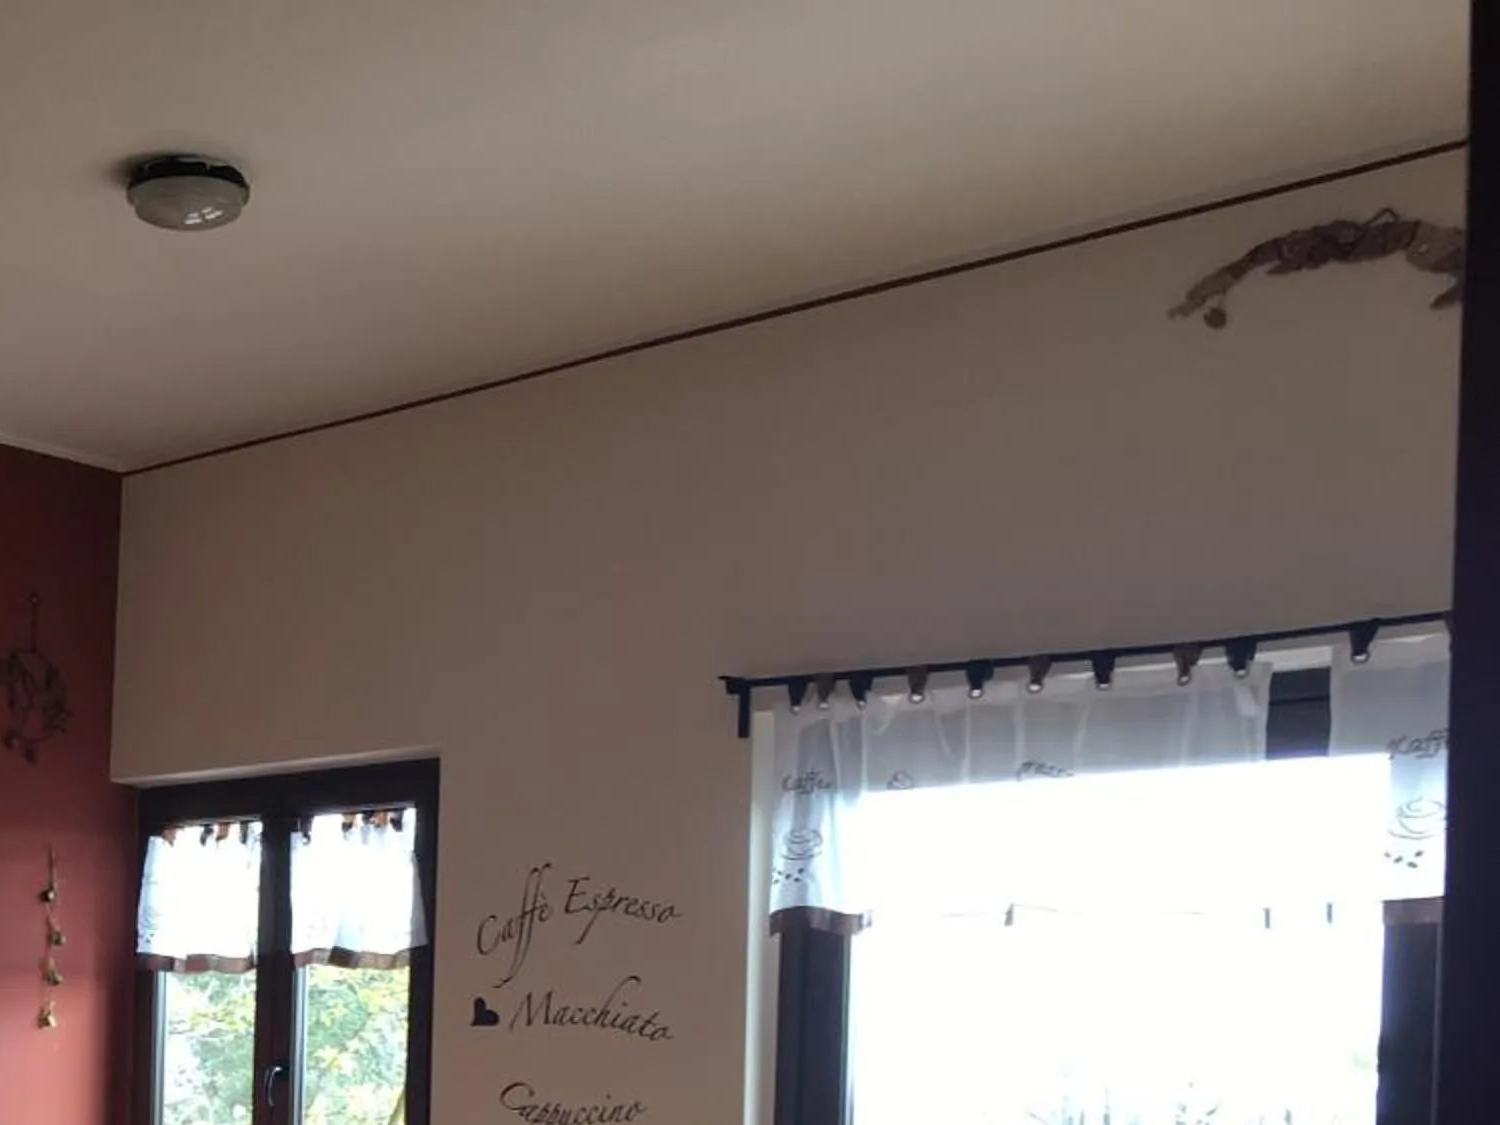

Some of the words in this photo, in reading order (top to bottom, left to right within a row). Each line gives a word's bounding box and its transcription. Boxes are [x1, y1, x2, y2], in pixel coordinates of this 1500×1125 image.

[477, 863, 552, 988] Caffè
[564, 877, 684, 944] Espresso
[508, 975, 675, 1041] Macchiato
